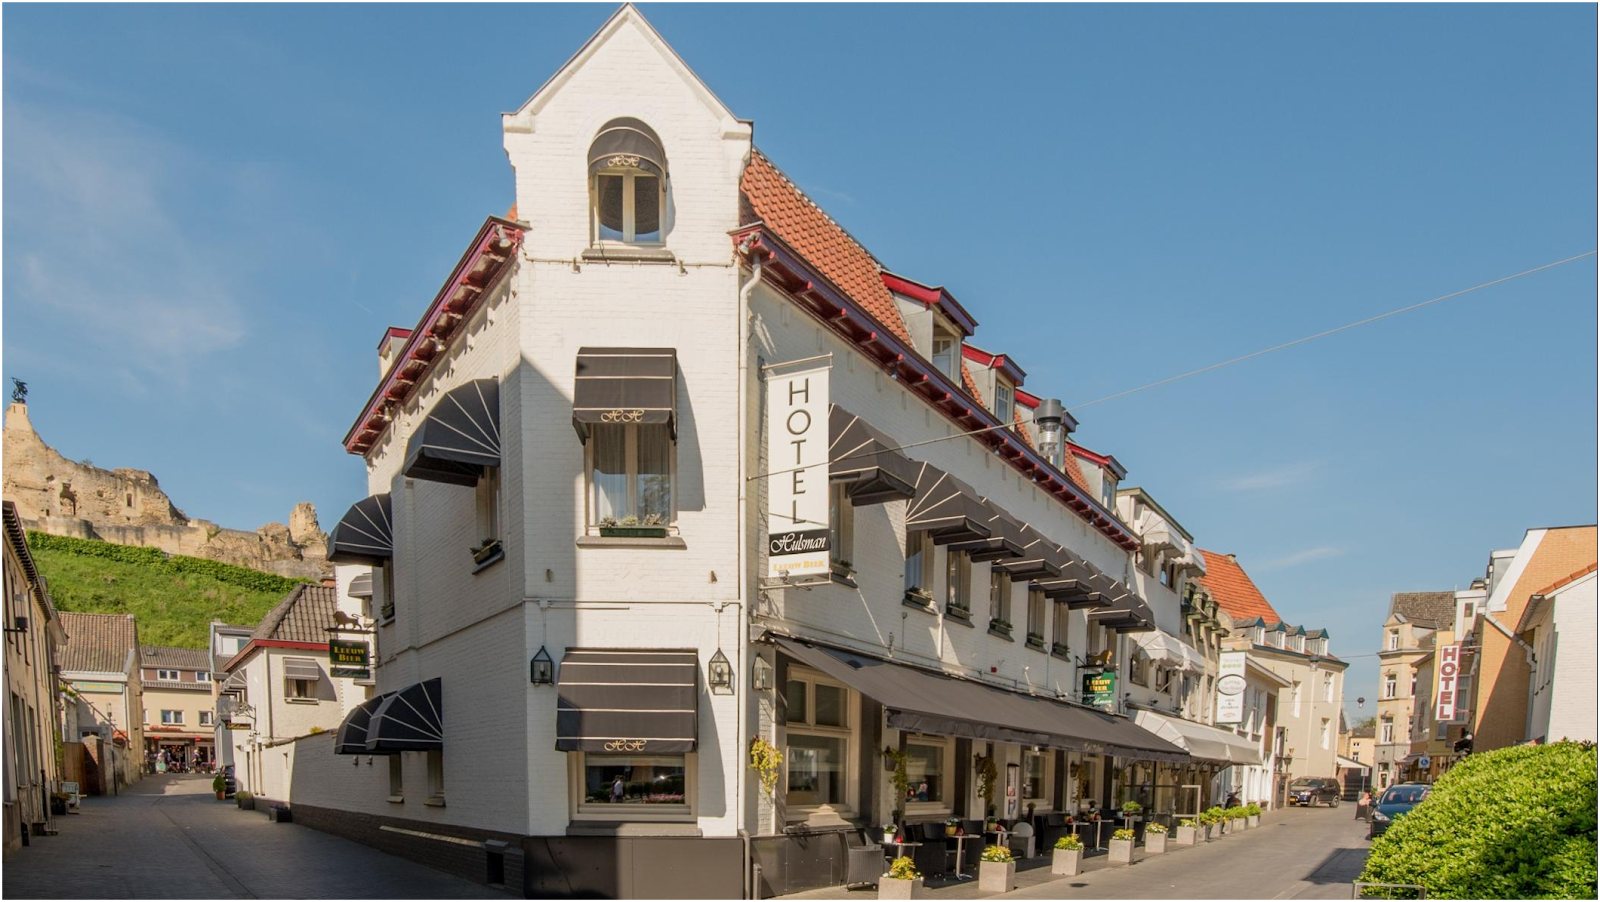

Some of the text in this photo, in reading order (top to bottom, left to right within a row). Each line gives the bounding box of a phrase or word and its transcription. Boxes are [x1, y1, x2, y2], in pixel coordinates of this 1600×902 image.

[786, 377, 812, 525] HOTEL
[770, 532, 827, 553] Hulsman
[334, 646, 365, 655] LEEUW
[338, 654, 362, 662] BIER
[1439, 647, 1457, 719] HOTEL
